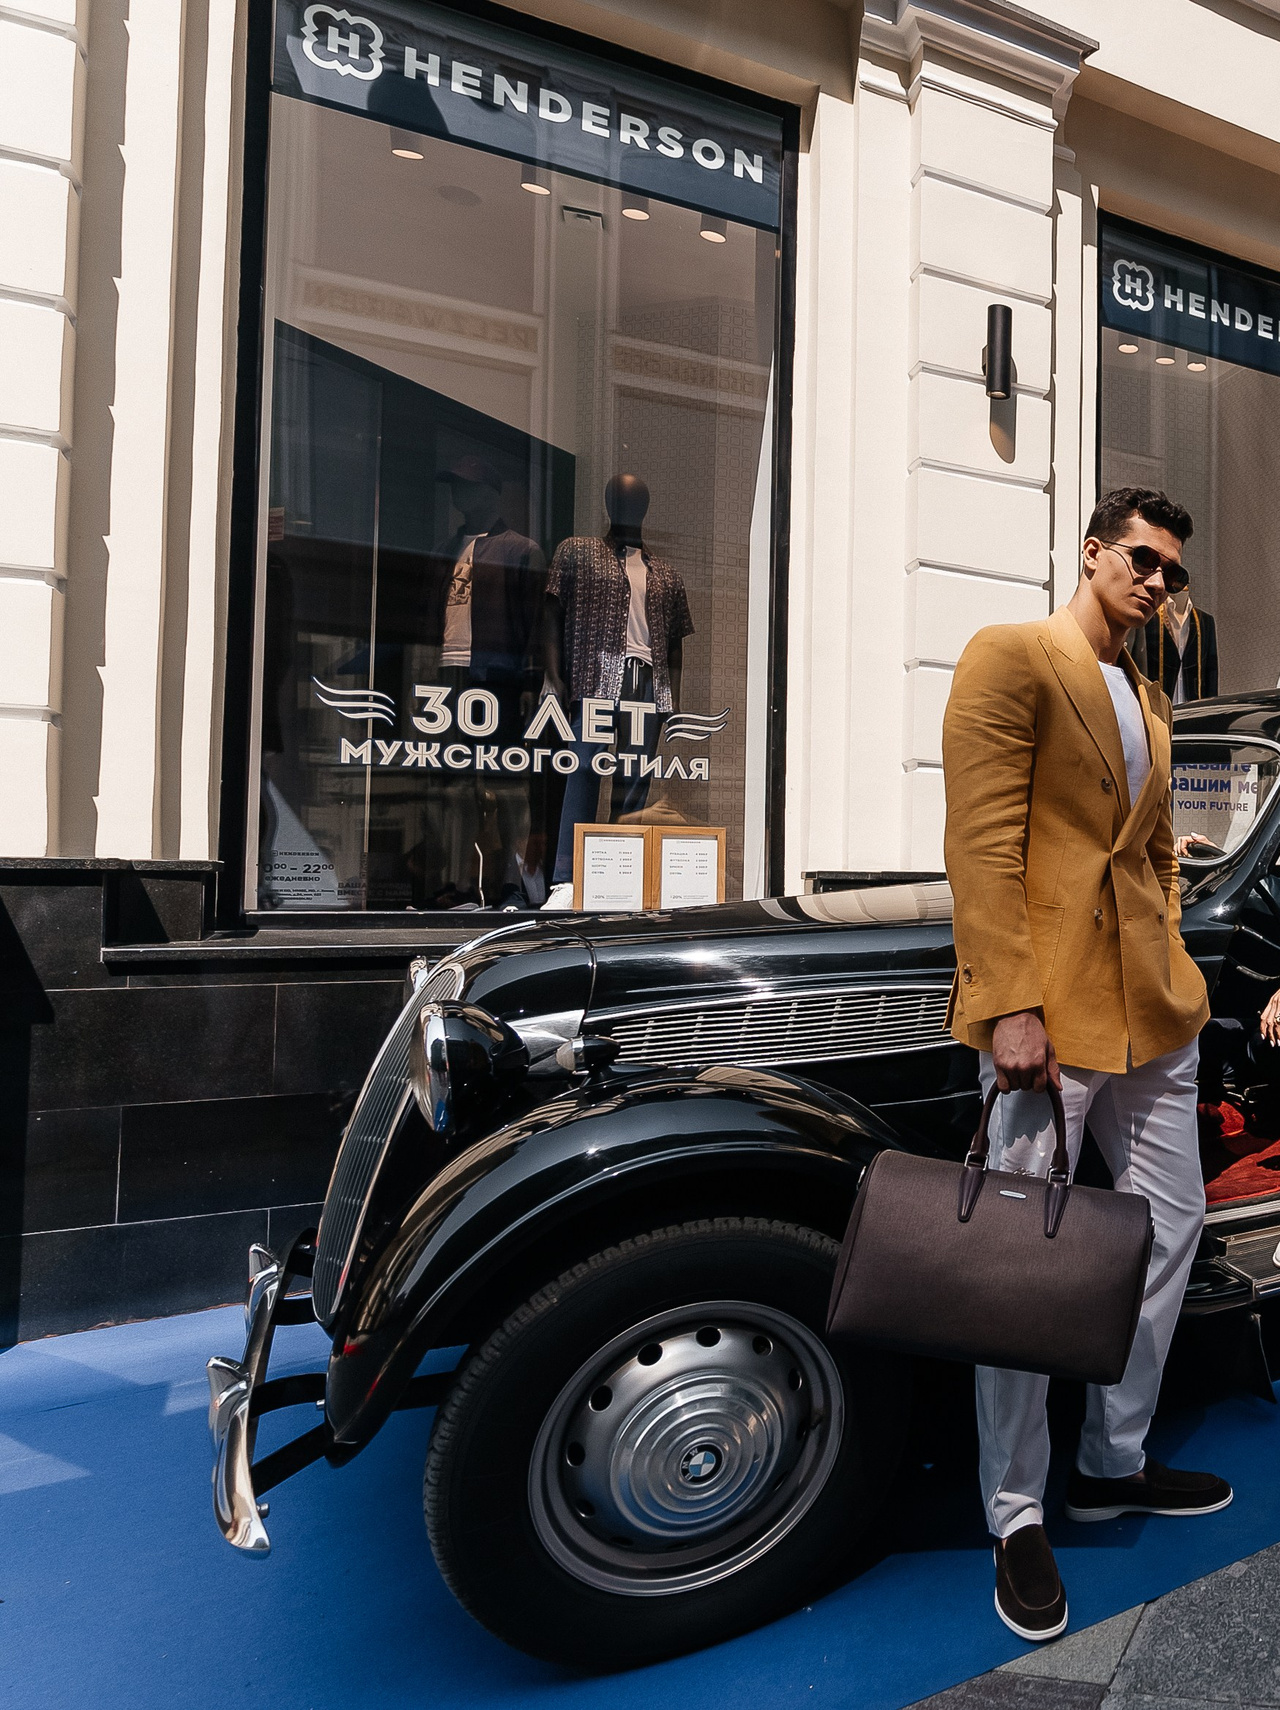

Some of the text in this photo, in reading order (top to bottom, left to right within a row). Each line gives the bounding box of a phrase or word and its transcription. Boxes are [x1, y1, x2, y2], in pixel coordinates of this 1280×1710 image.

[403, 46, 765, 184] HENDERSON
[412, 683, 657, 746] 30 ЛЕТ
[340, 737, 711, 782] МУЖСКОГО СТИЛЯ
[1177, 800, 1249, 812] YOUR FUTURE
